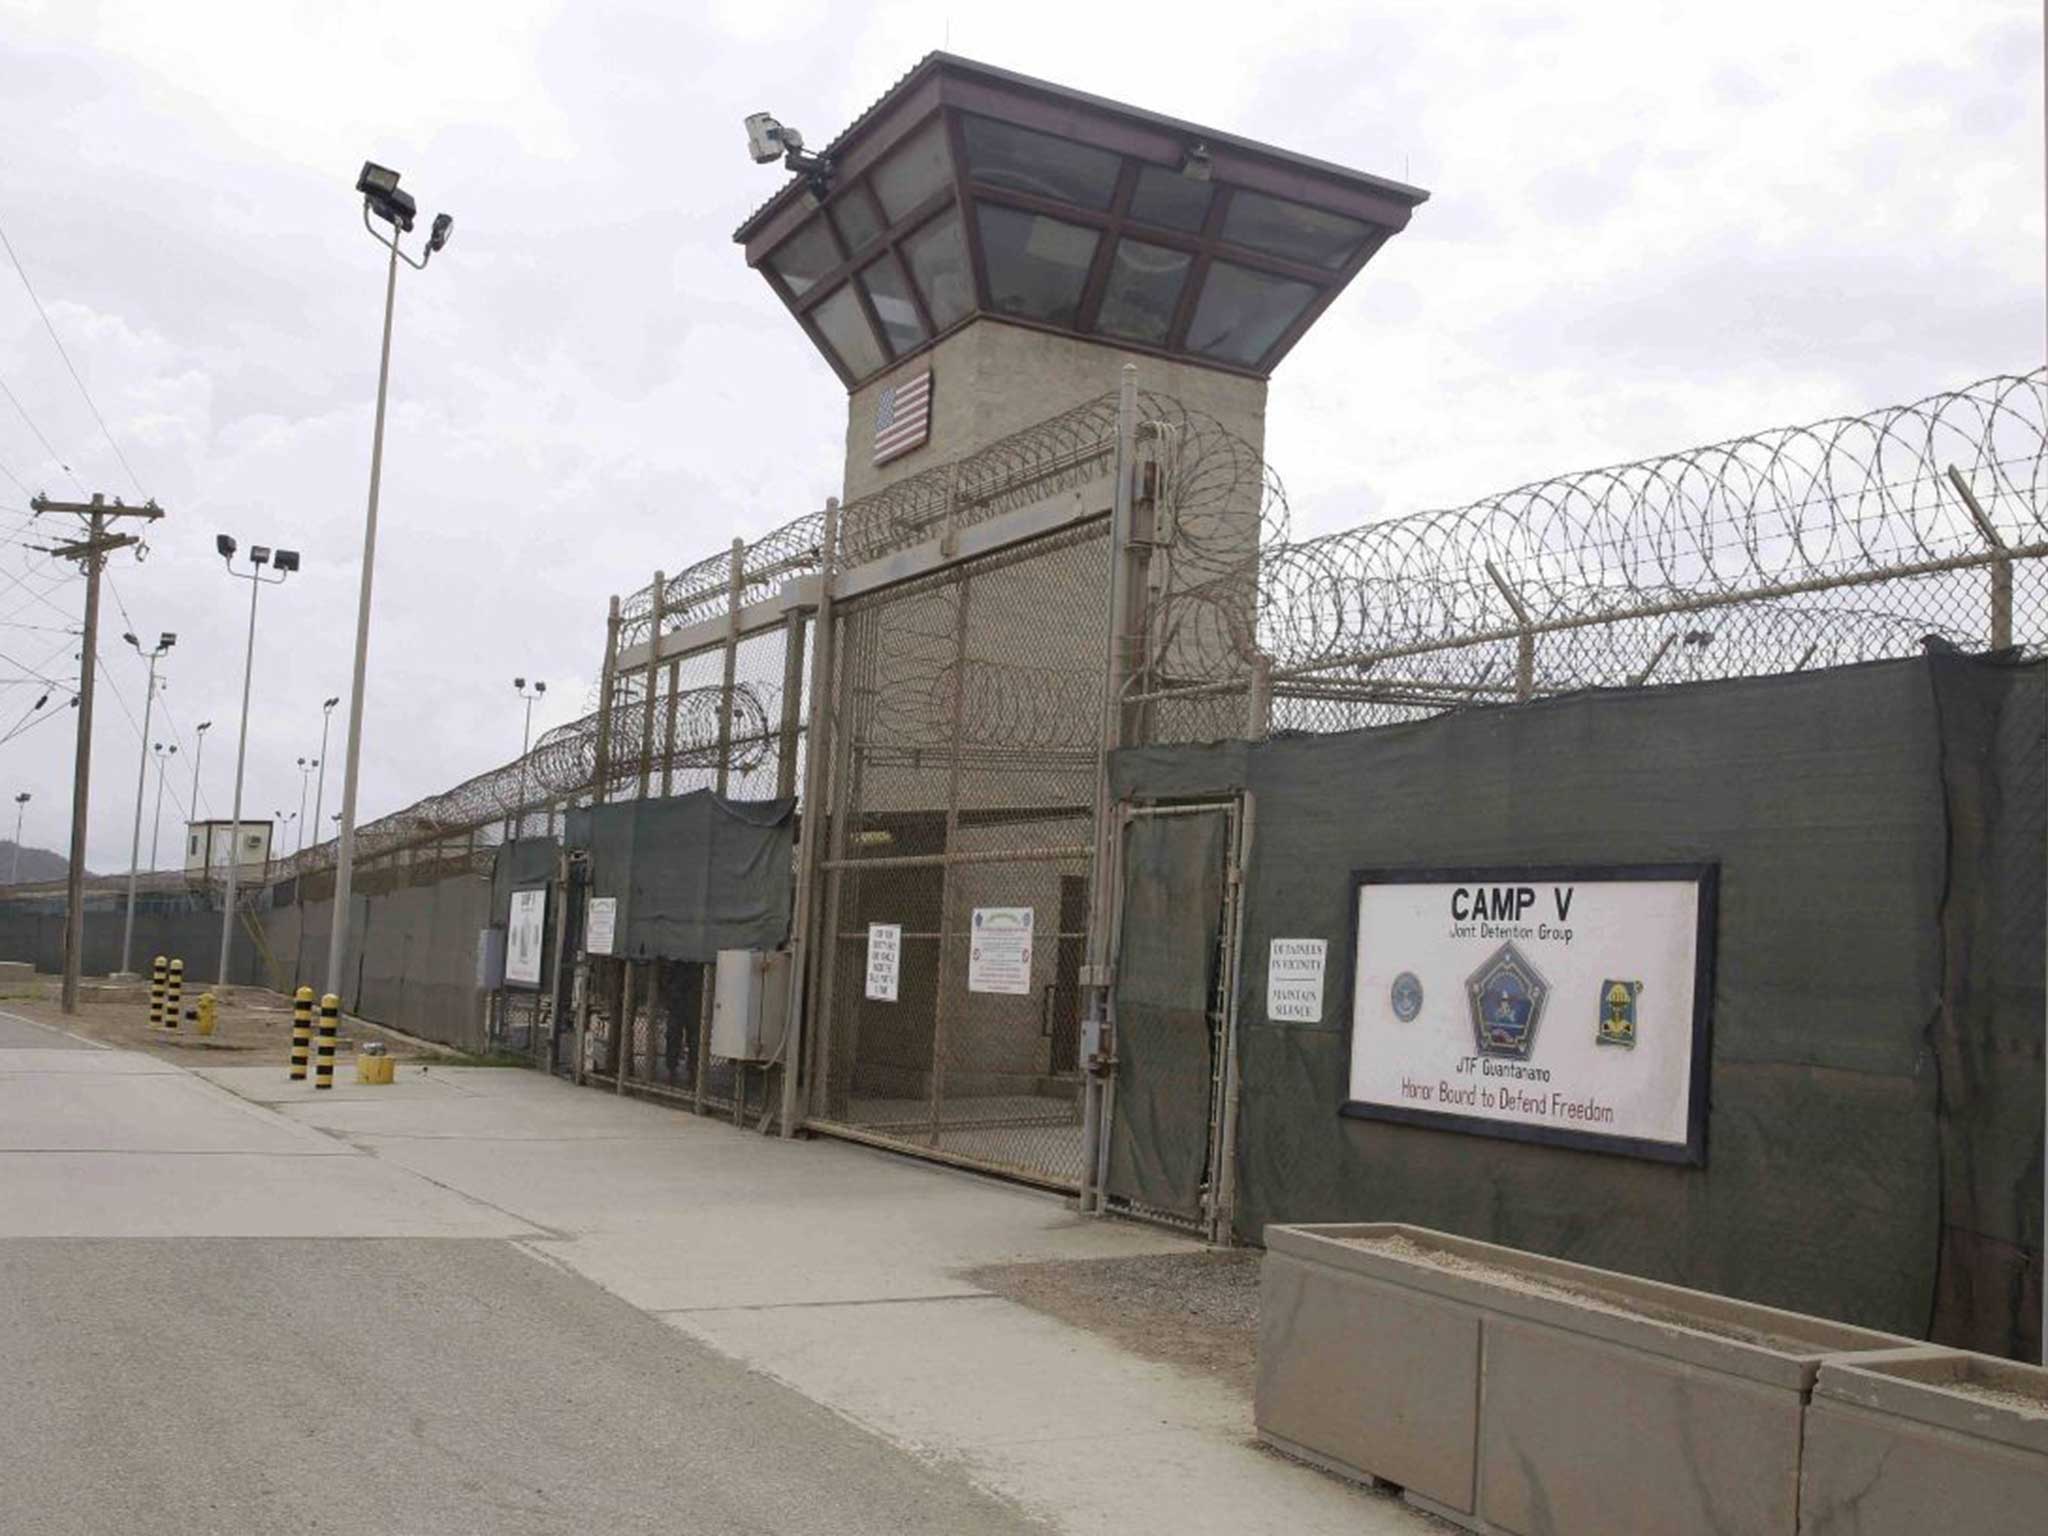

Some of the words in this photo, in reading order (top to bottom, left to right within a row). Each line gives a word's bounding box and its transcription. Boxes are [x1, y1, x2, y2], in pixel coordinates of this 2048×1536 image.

[1452, 888, 1536, 921] CAMP
[1554, 888, 1574, 921] V
[1449, 922, 1476, 938] Joint
[1481, 922, 1533, 939] Detention
[1539, 923, 1573, 944] Group
[1456, 1056, 1478, 1075] JTF
[1482, 1058, 1551, 1082] Guantanamo
[1401, 1077, 1434, 1098] Honor
[1439, 1081, 1477, 1106] Bound
[1481, 1089, 1495, 1108] to
[1499, 1087, 1547, 1115] Defend
[1551, 1092, 1615, 1122] Freedom
